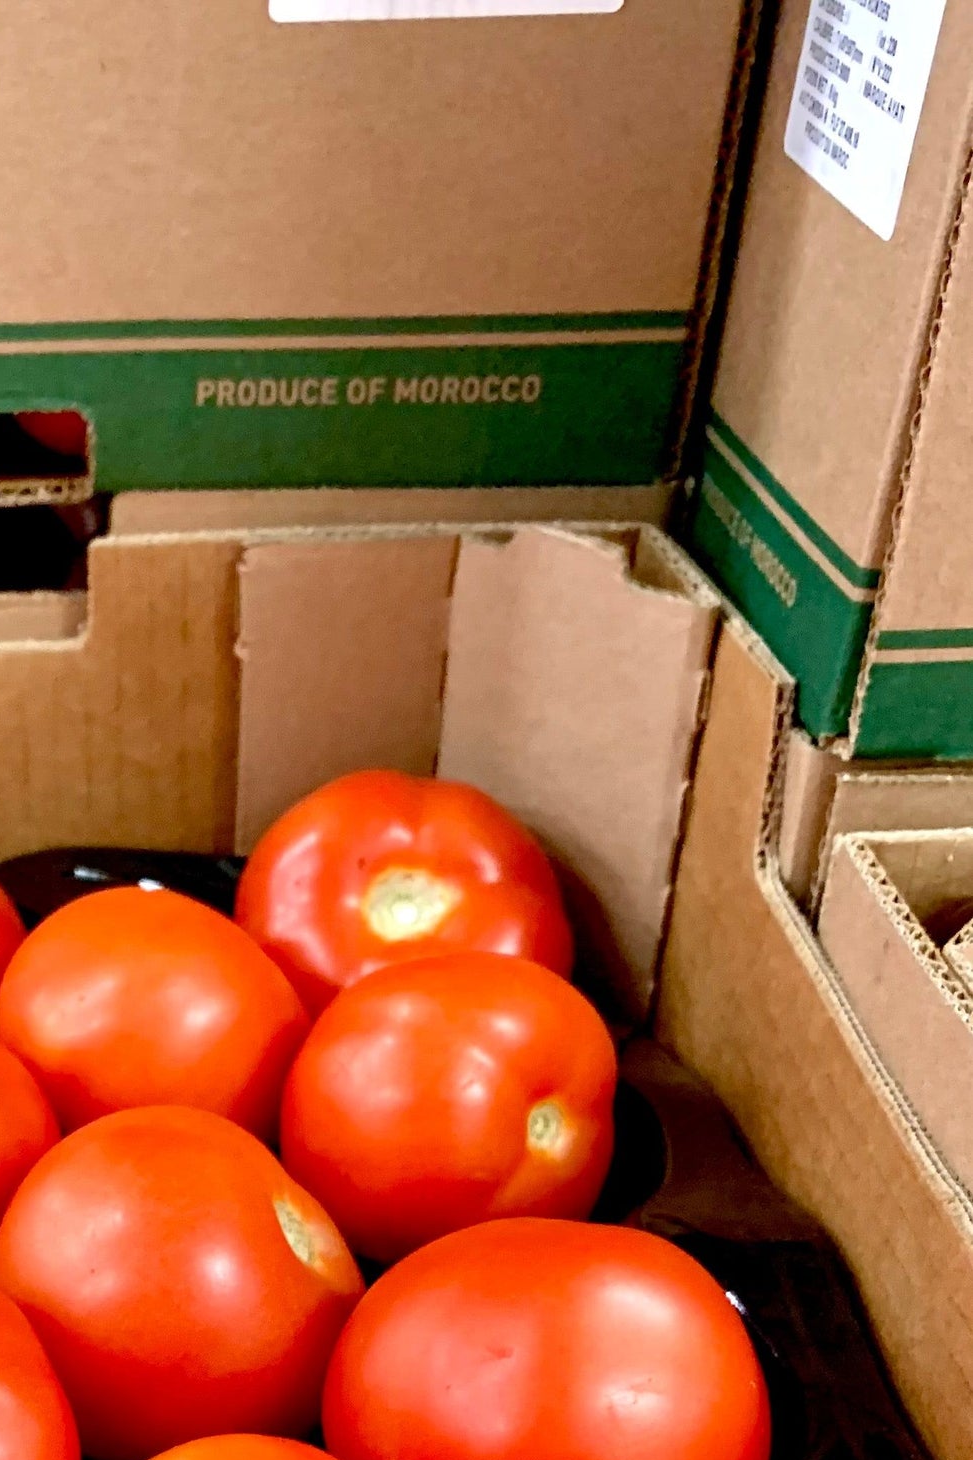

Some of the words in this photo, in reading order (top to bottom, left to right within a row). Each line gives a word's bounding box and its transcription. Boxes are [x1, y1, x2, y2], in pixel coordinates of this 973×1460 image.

[195, 377, 339, 407] PRODUCE
[346, 376, 388, 405] OF
[393, 374, 542, 404] MOROCCO
